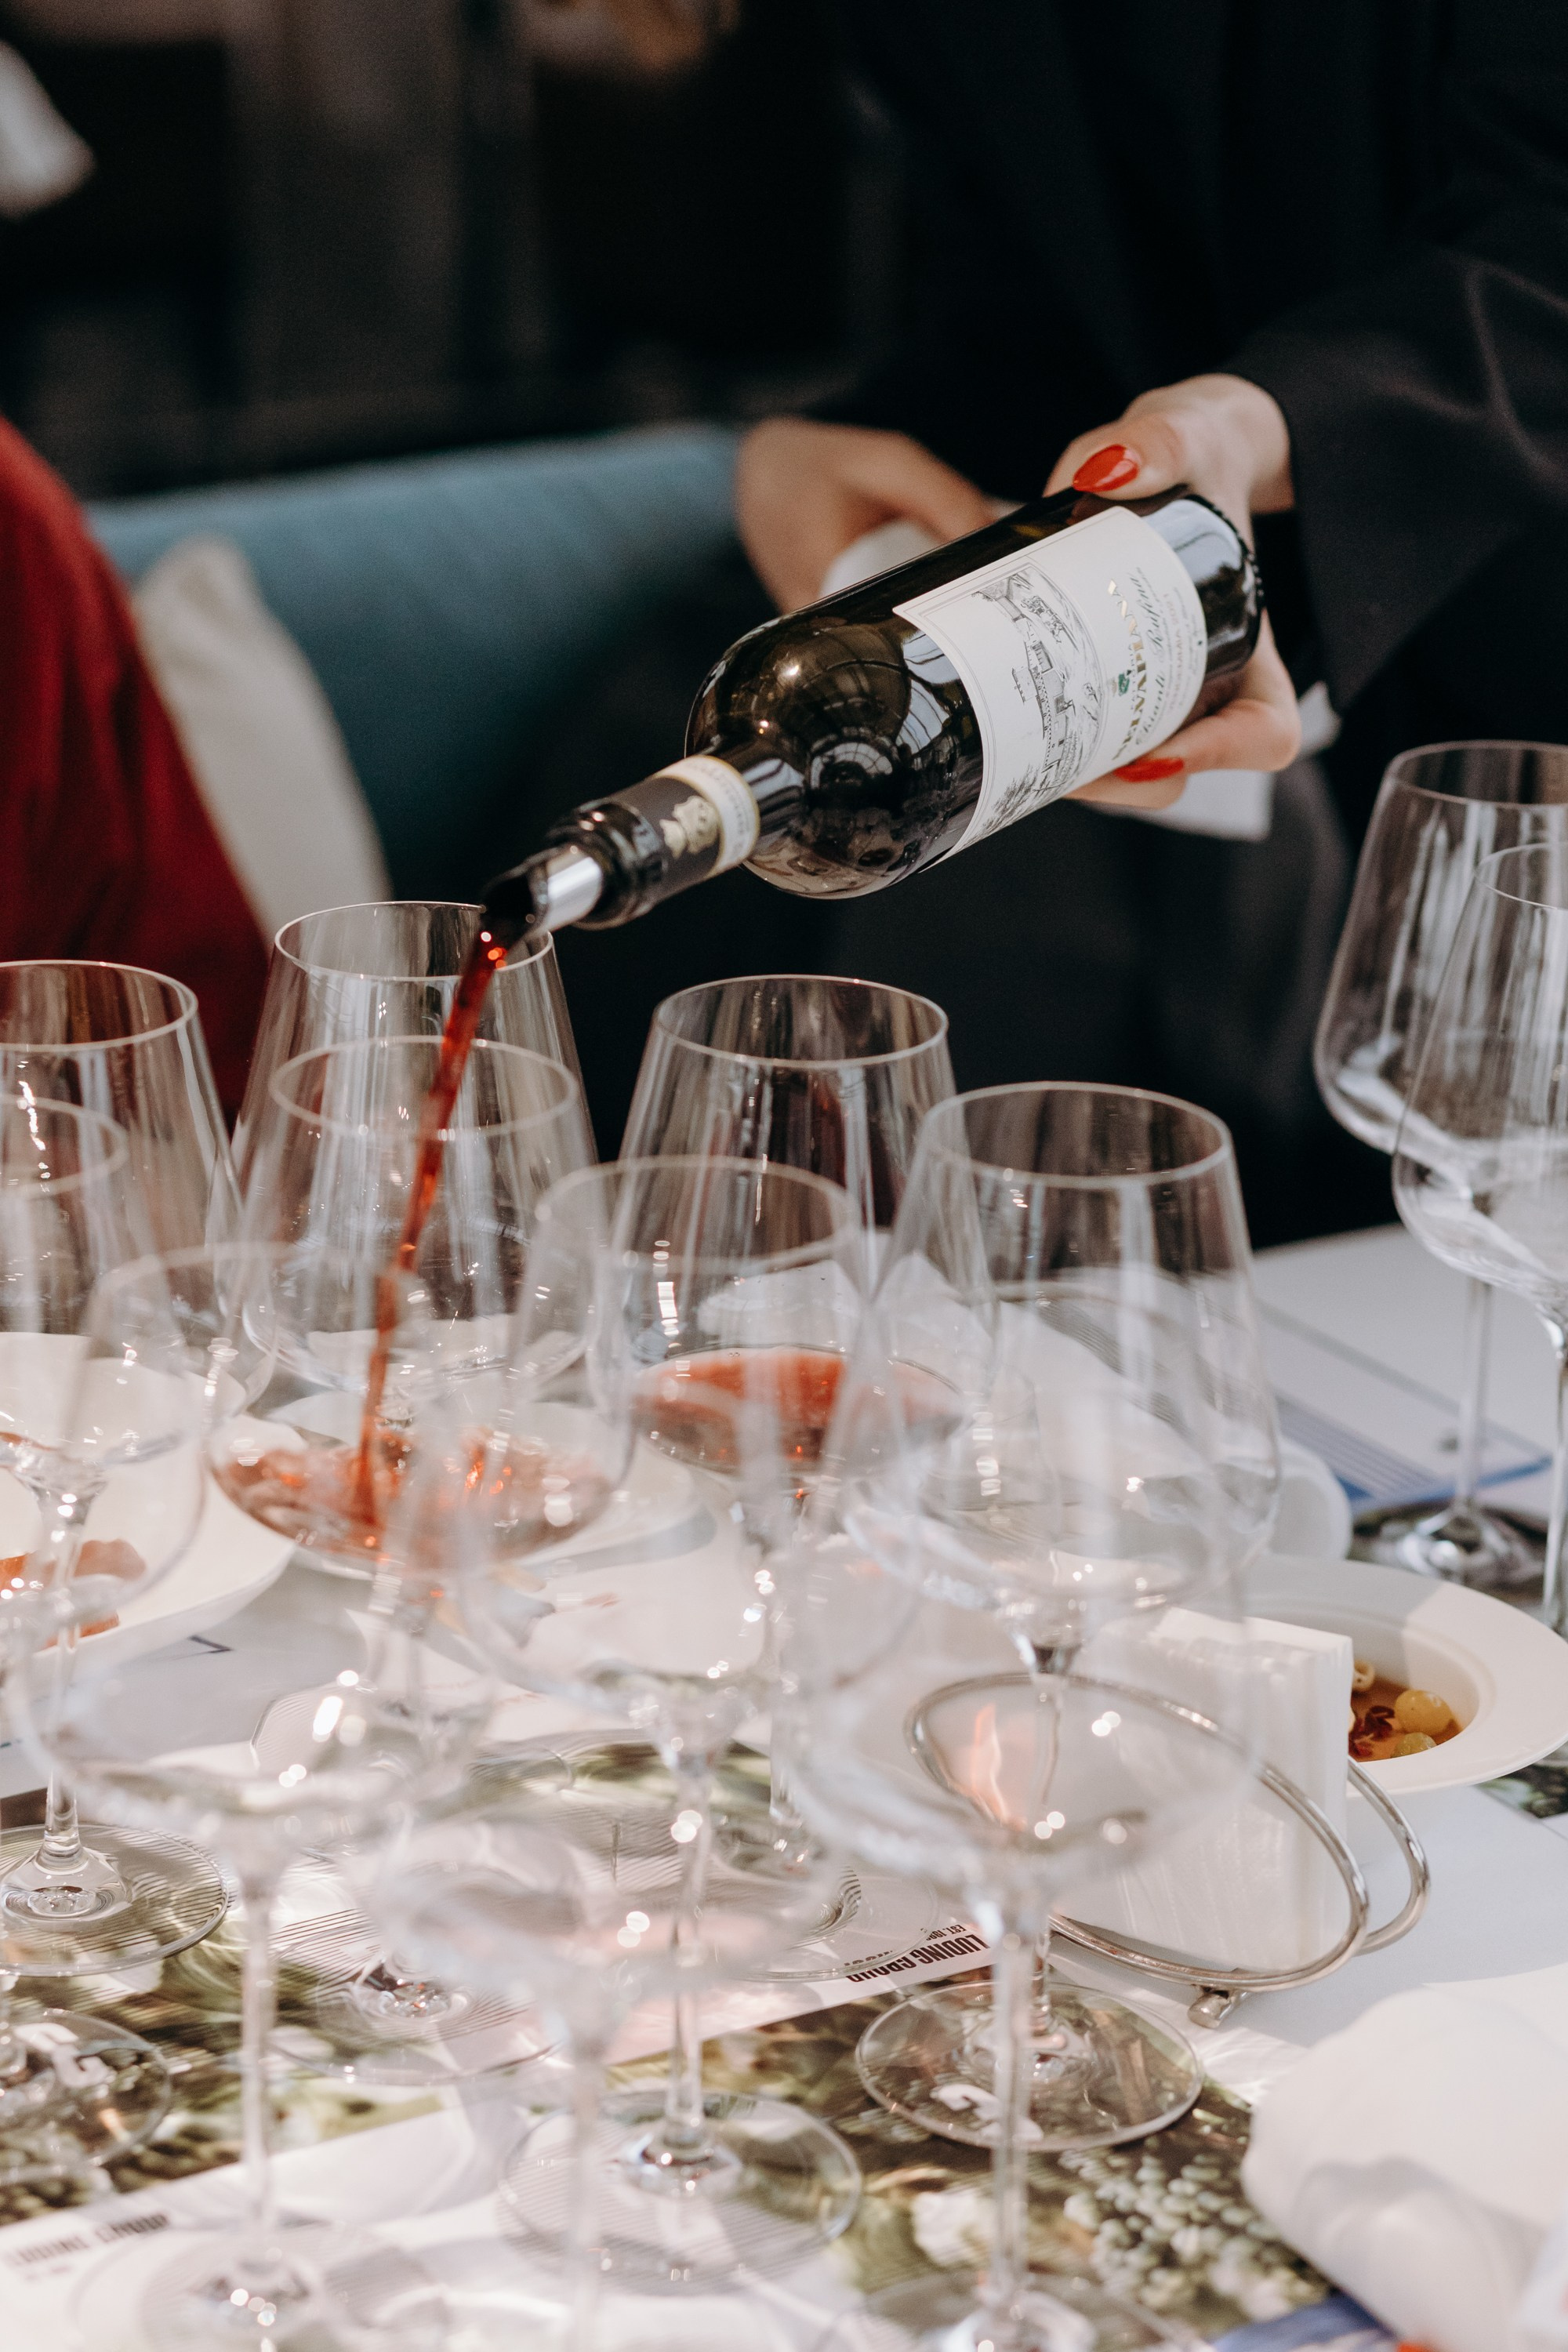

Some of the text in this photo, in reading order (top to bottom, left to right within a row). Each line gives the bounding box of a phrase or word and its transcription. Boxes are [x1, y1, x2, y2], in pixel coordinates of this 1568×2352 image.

[1127, 571, 1166, 663] Rufina
[1108, 579, 1148, 760] SELVAPIANA
[1135, 671, 1166, 745] Chianti
[909, 1934, 991, 1965] LUDING
[942, 1924, 967, 1936] EST.
